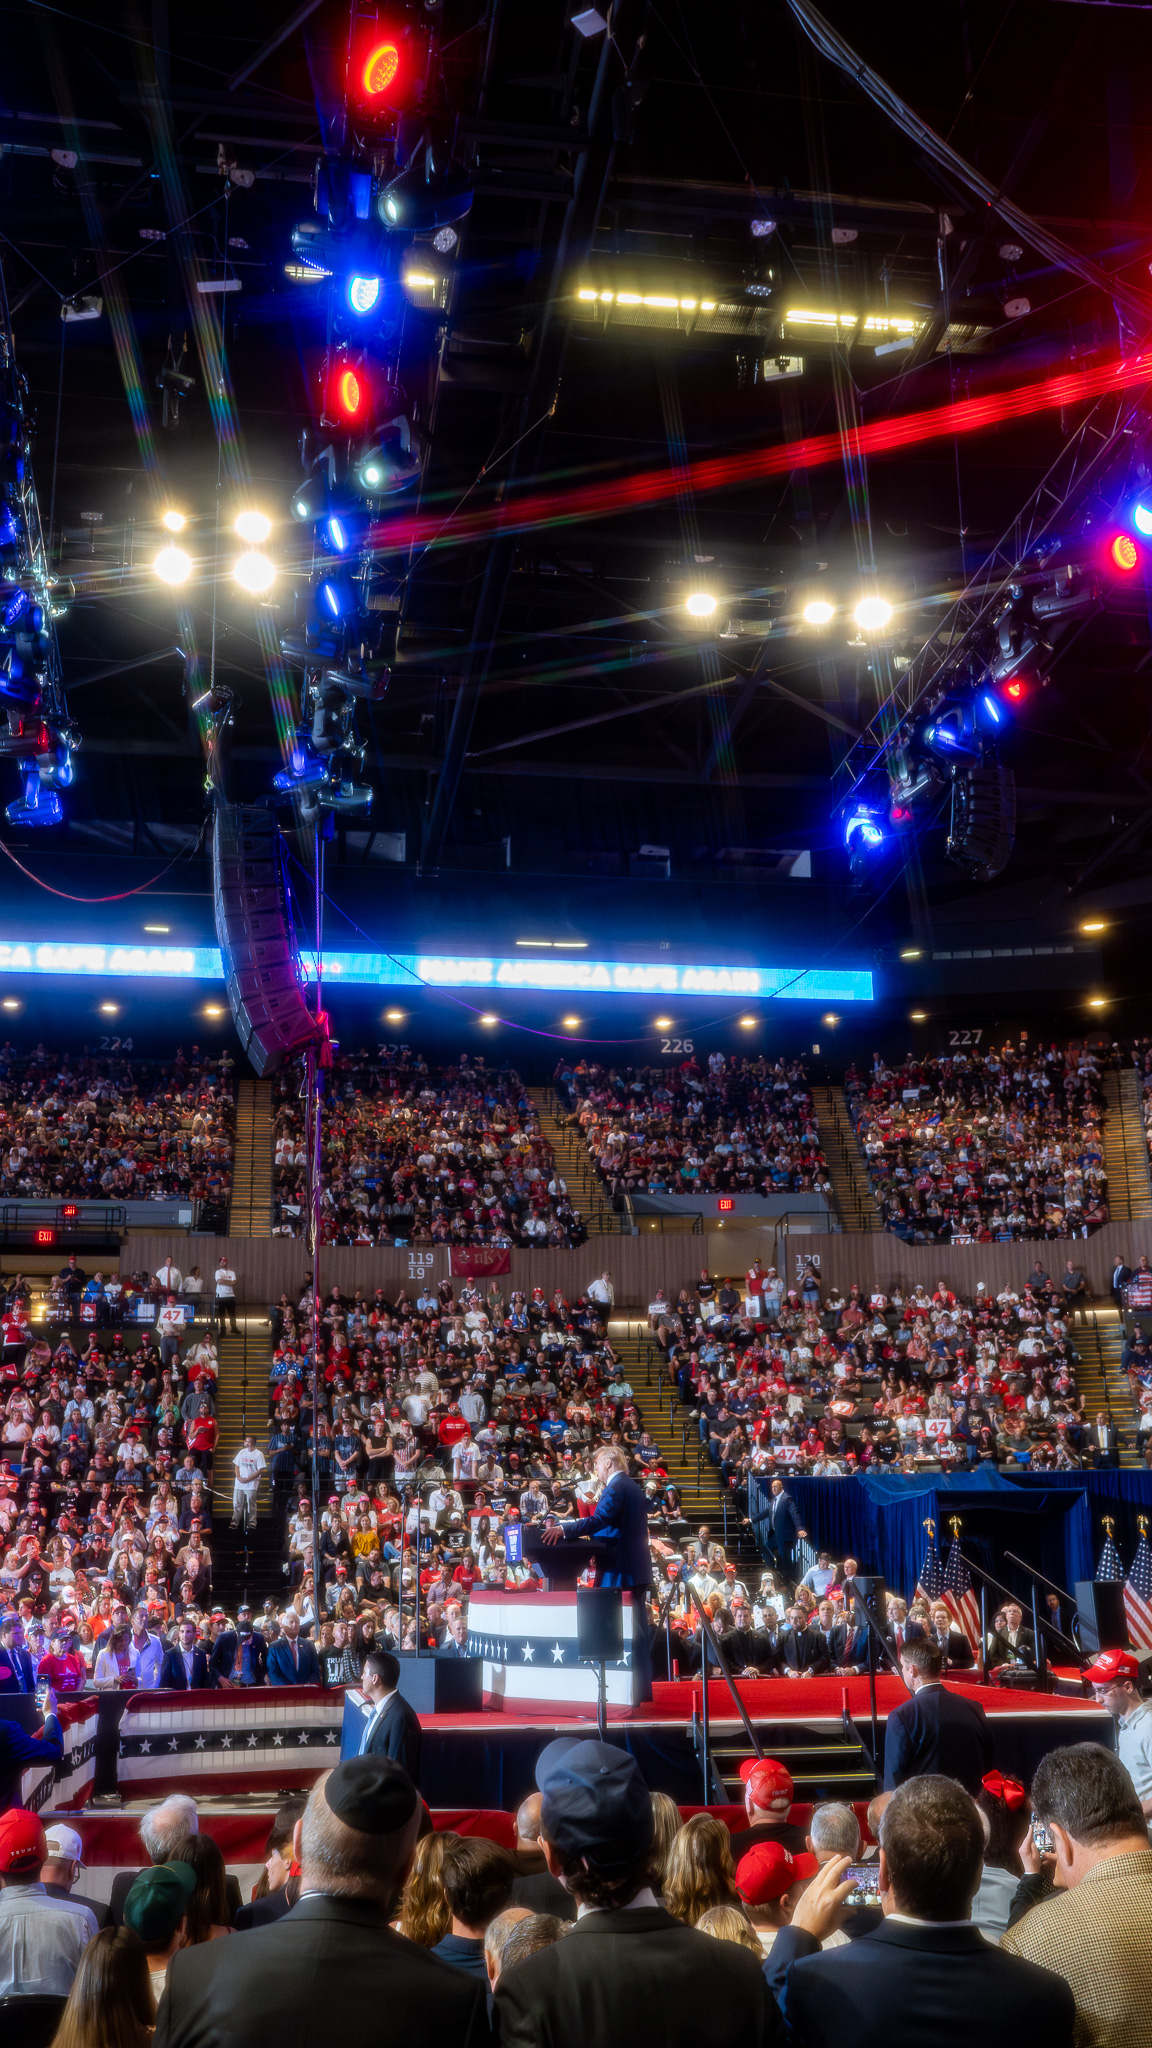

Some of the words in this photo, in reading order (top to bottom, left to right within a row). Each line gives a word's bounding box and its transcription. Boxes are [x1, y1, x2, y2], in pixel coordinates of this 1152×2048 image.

[100, 1036, 133, 1051] 224
[949, 1029, 983, 1046] 227
[661, 1039, 694, 1053] 226
[720, 1199, 732, 1209] EXIT
[38, 1230, 53, 1241] EXIT
[408, 1252, 434, 1265] 119
[408, 1267, 425, 1279] 19
[162, 1310, 181, 1321] 47
[831, 1401, 851, 1413] 47
[928, 1421, 947, 1434] 47
[778, 1448, 796, 1461] 47
[10, 1846, 36, 1856] TRUMP
